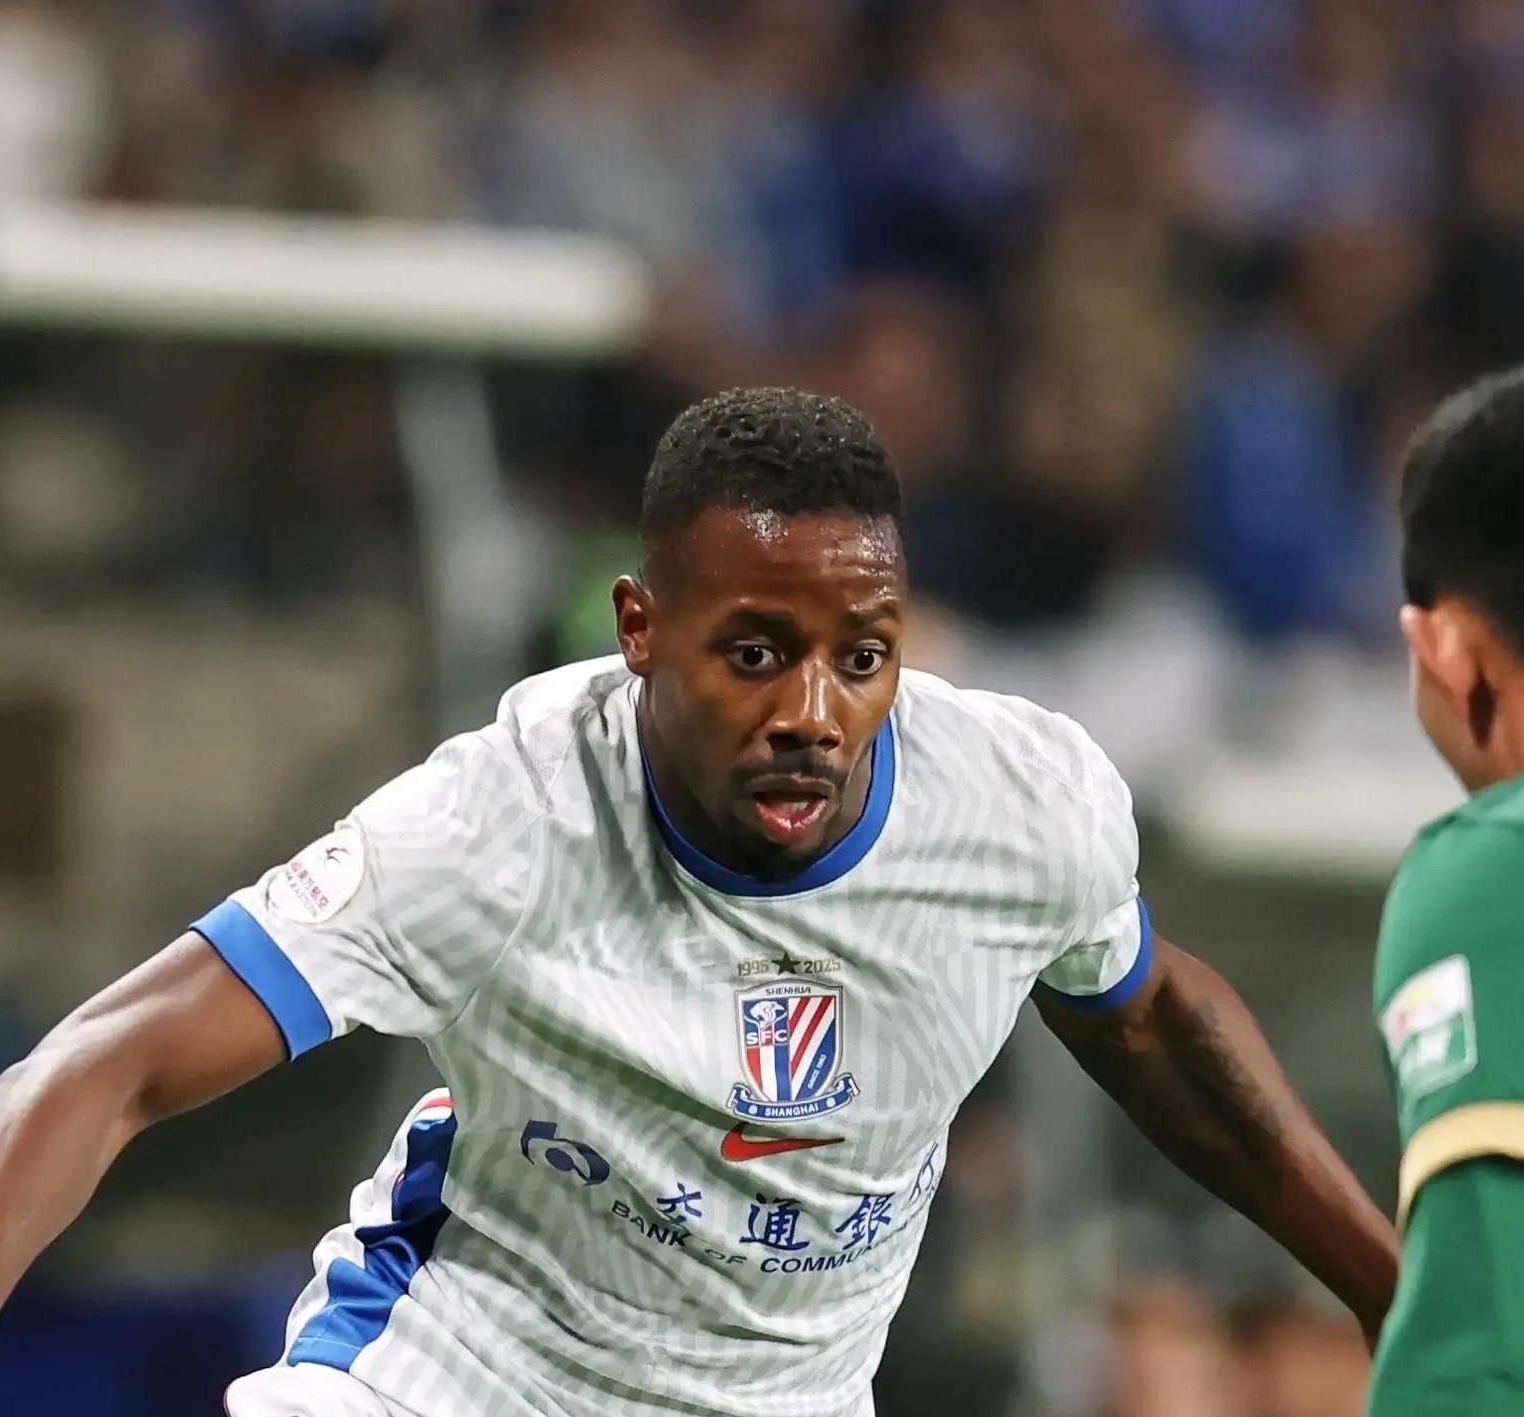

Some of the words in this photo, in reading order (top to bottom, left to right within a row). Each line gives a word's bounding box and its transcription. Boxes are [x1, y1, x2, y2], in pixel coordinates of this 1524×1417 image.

[803, 959, 842, 975] 2025
[765, 986, 812, 996] SHENHUA
[746, 1030, 789, 1045] SFC
[765, 1102, 819, 1118] SHANGHAI
[611, 1200, 692, 1248] BANK
[704, 1248, 748, 1266] OF
